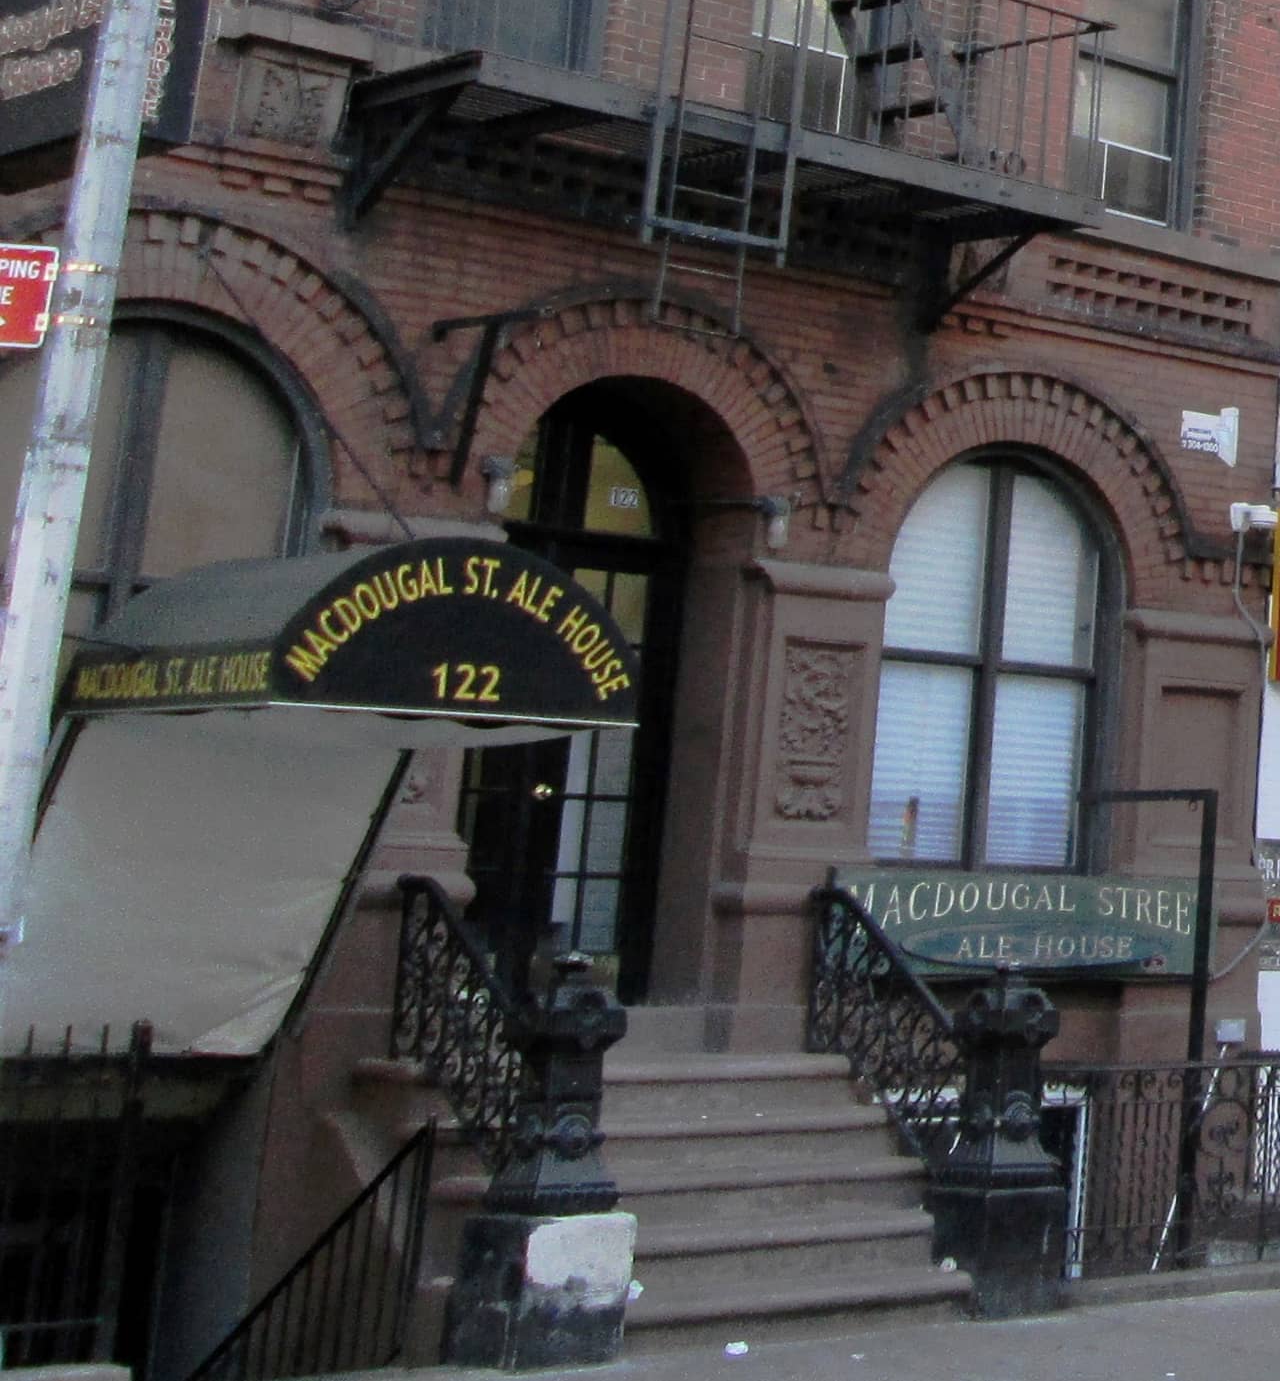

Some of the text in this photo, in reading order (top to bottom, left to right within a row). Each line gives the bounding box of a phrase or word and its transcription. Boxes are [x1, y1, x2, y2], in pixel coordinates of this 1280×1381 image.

[0, 286, 14, 305] E
[612, 488, 638, 508] 122
[285, 556, 631, 701] MACDOUGAL ST. ALE HOUSE
[75, 660, 159, 699] MACDOUGAL
[188, 654, 220, 693] ALE
[219, 651, 272, 693] HOUSE
[431, 662, 501, 702] 122
[1097, 885, 1198, 936] STREE
[958, 935, 1133, 959] ALE HOUSE
